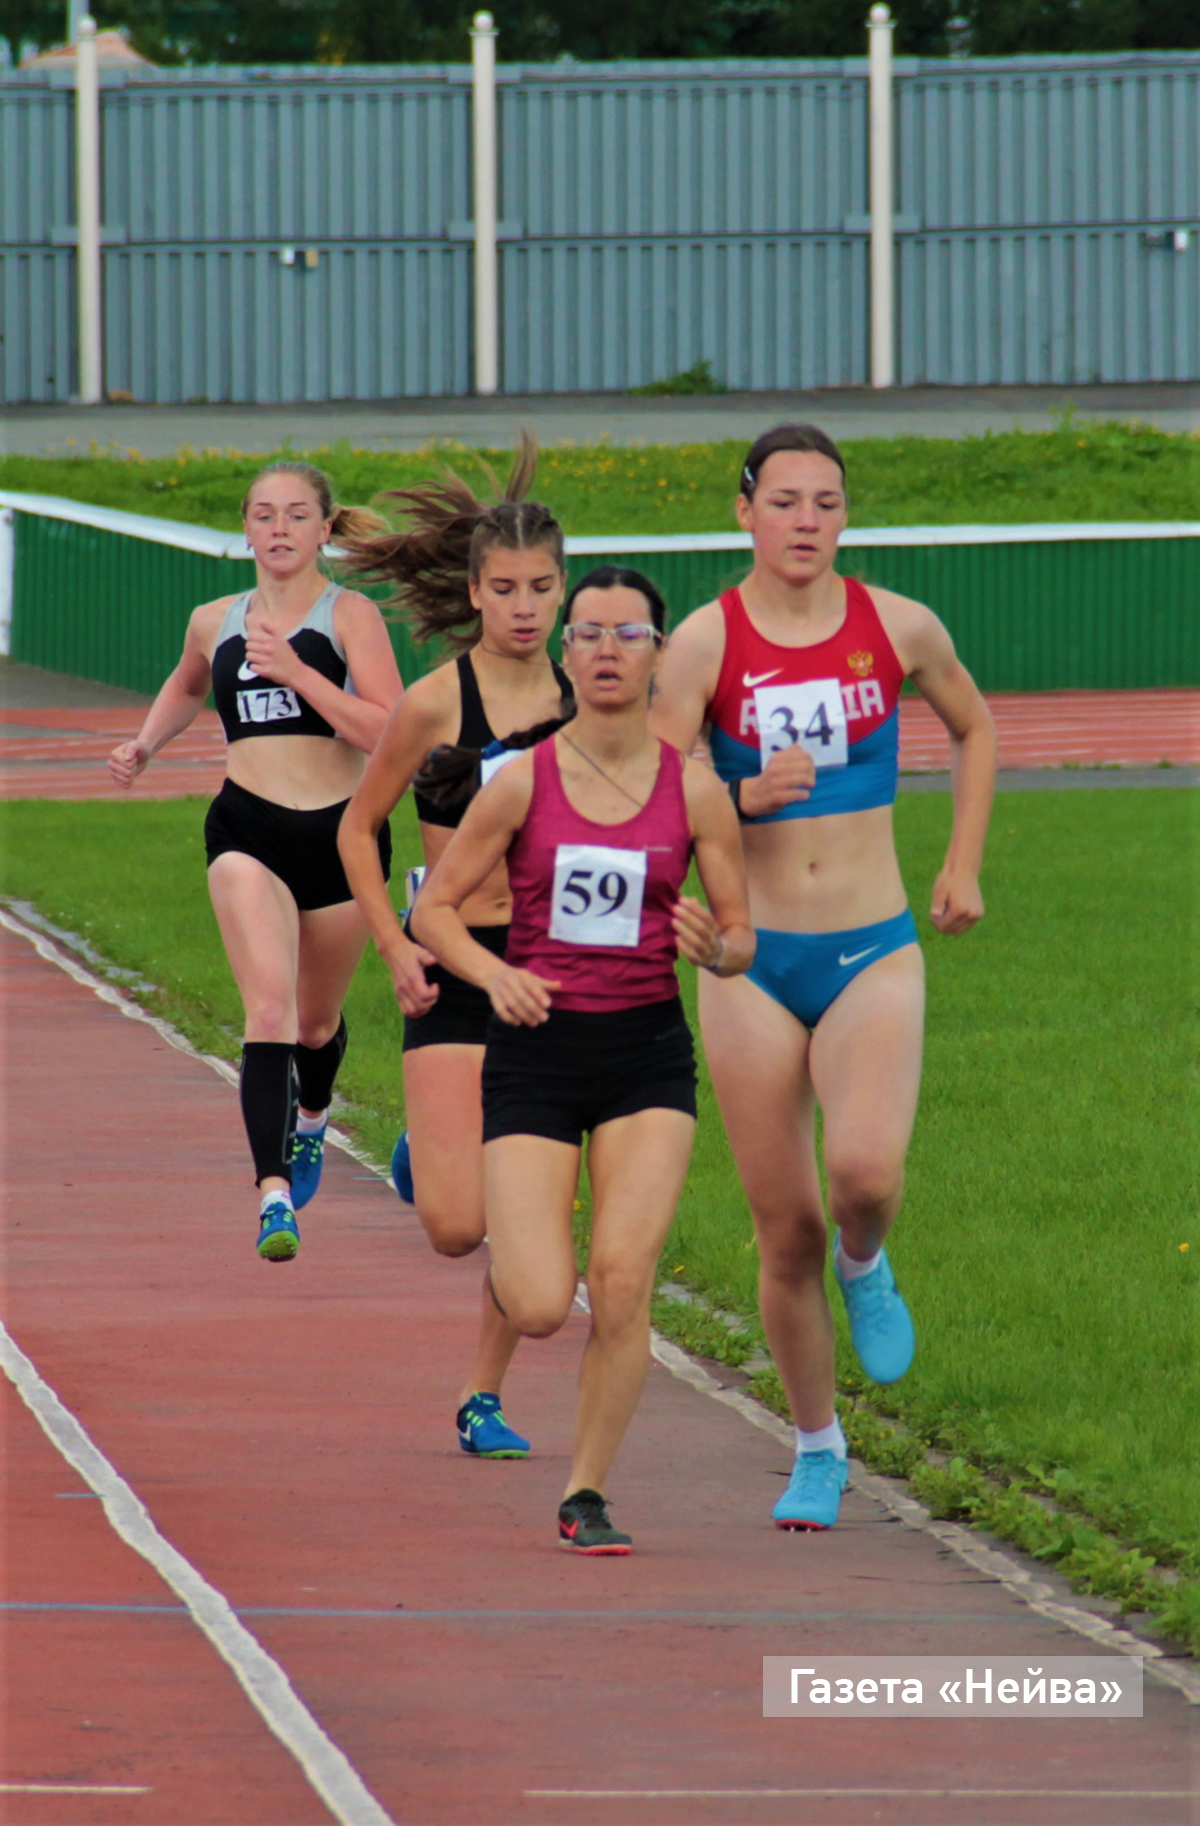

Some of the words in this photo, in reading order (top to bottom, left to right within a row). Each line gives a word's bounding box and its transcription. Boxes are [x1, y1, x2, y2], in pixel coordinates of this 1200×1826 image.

[241, 689, 293, 721] 173
[769, 700, 834, 752] 34
[560, 869, 628, 918] 59
